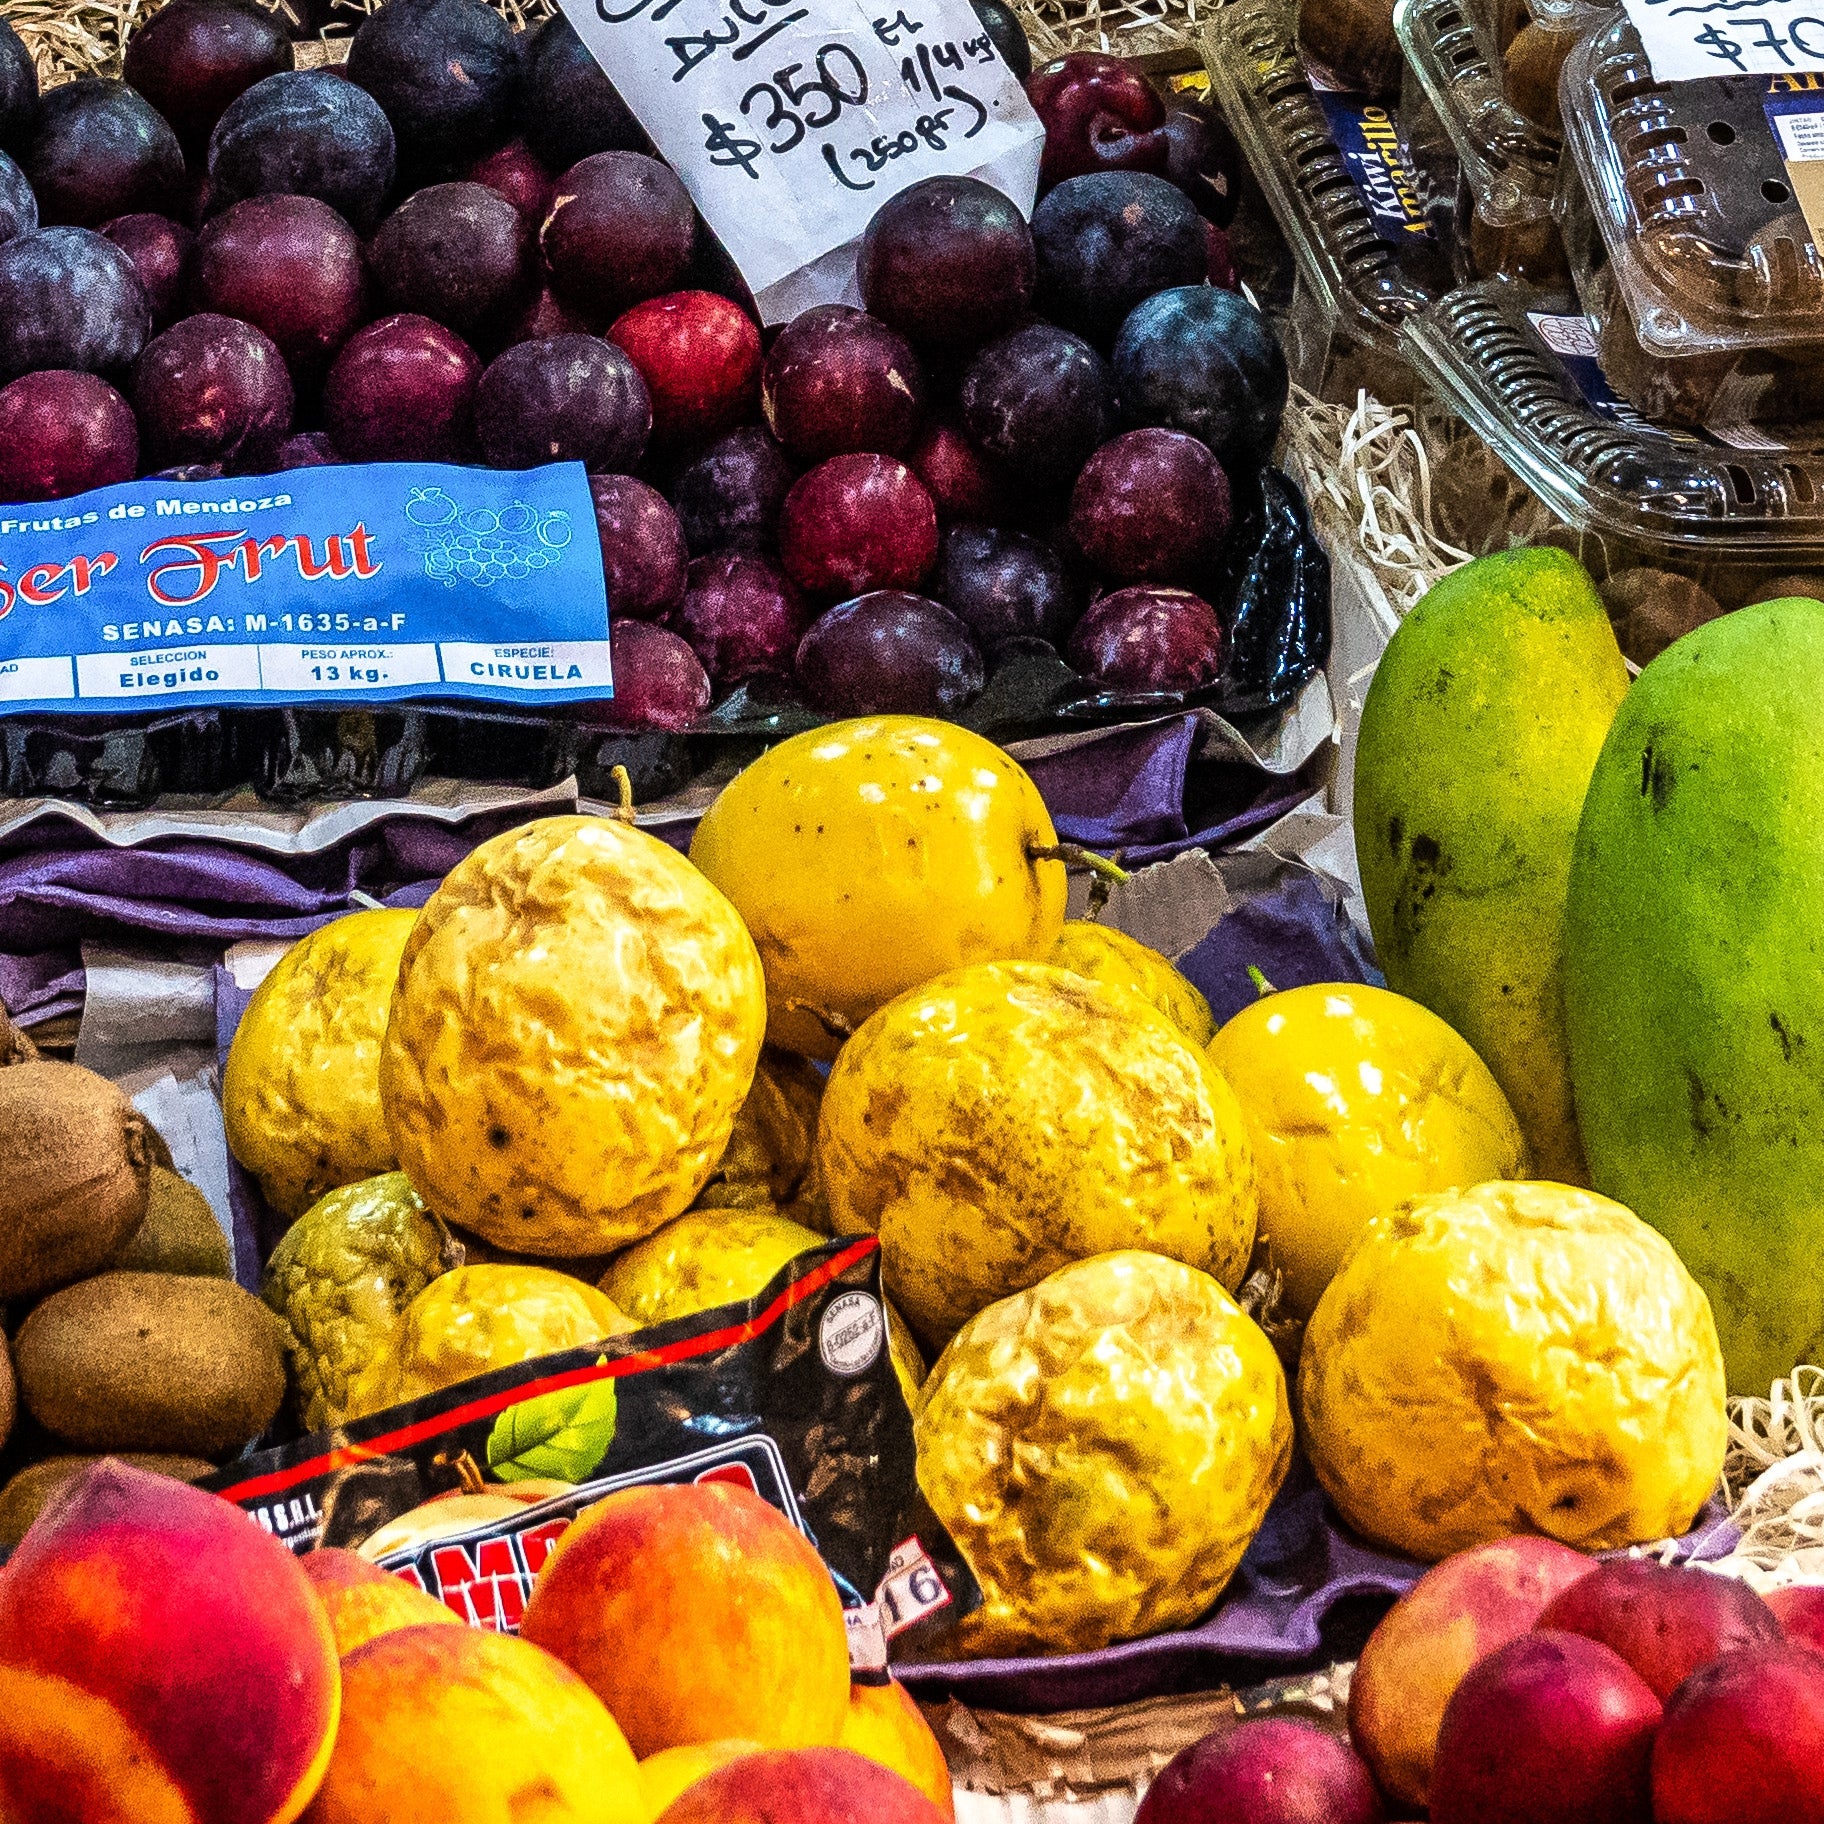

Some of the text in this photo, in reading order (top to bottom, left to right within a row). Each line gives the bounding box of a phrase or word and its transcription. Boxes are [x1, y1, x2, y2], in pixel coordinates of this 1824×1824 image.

[701, 42, 870, 180] $350
[900, 42, 965, 102] 1/4
[1347, 151, 1408, 222] Kiwi
[0, 491, 293, 535] Frutas de Mendoza
[139, 520, 384, 608] Frut
[102, 612, 407, 643] SENASA: M-1635-a-F
[129, 649, 208, 667] SELECCION
[300, 648, 338, 660] PESO
[119, 665, 220, 689] Elegido
[310, 664, 389, 684] 13 kg.
[469, 661, 584, 681] CIRUELA
[826, 1296, 861, 1324] SENASA
[884, 1563, 946, 1623] 16
